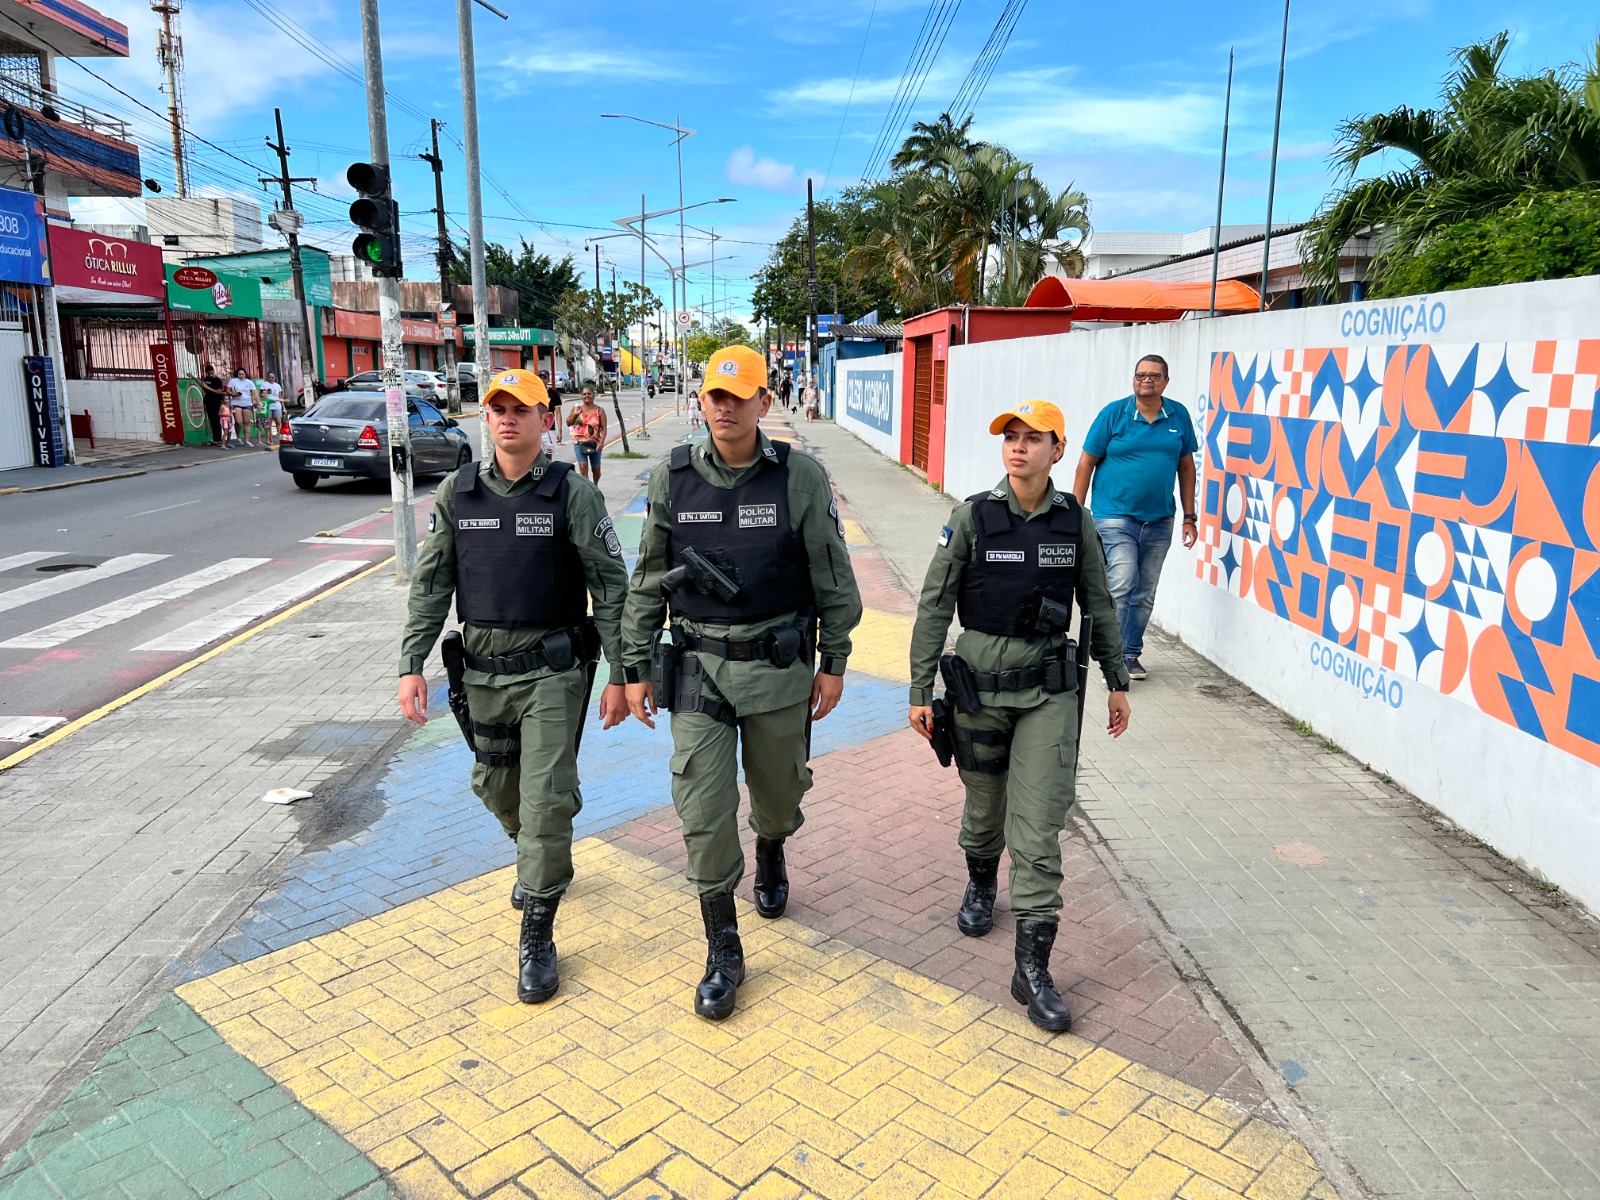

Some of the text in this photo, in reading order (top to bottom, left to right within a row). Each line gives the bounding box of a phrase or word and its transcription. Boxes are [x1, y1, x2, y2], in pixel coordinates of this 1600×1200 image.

[0, 244, 32, 257] ducacional
[84, 253, 138, 276] ÓTICA RILLUX
[1341, 296, 1446, 341] COGNIÇÃO
[520, 328, 531, 341] UTI
[156, 353, 176, 428] ÓTICA RILLUX
[740, 507, 775, 517] POLÍCIA
[517, 515, 552, 525] POLÍCIA
[740, 516, 775, 526] MILITAR
[517, 526, 551, 534] MILITAR
[1040, 546, 1074, 556] POLÍCIA
[1040, 557, 1073, 565] MILITAR
[1310, 641, 1403, 709] COGNIÇÃO
